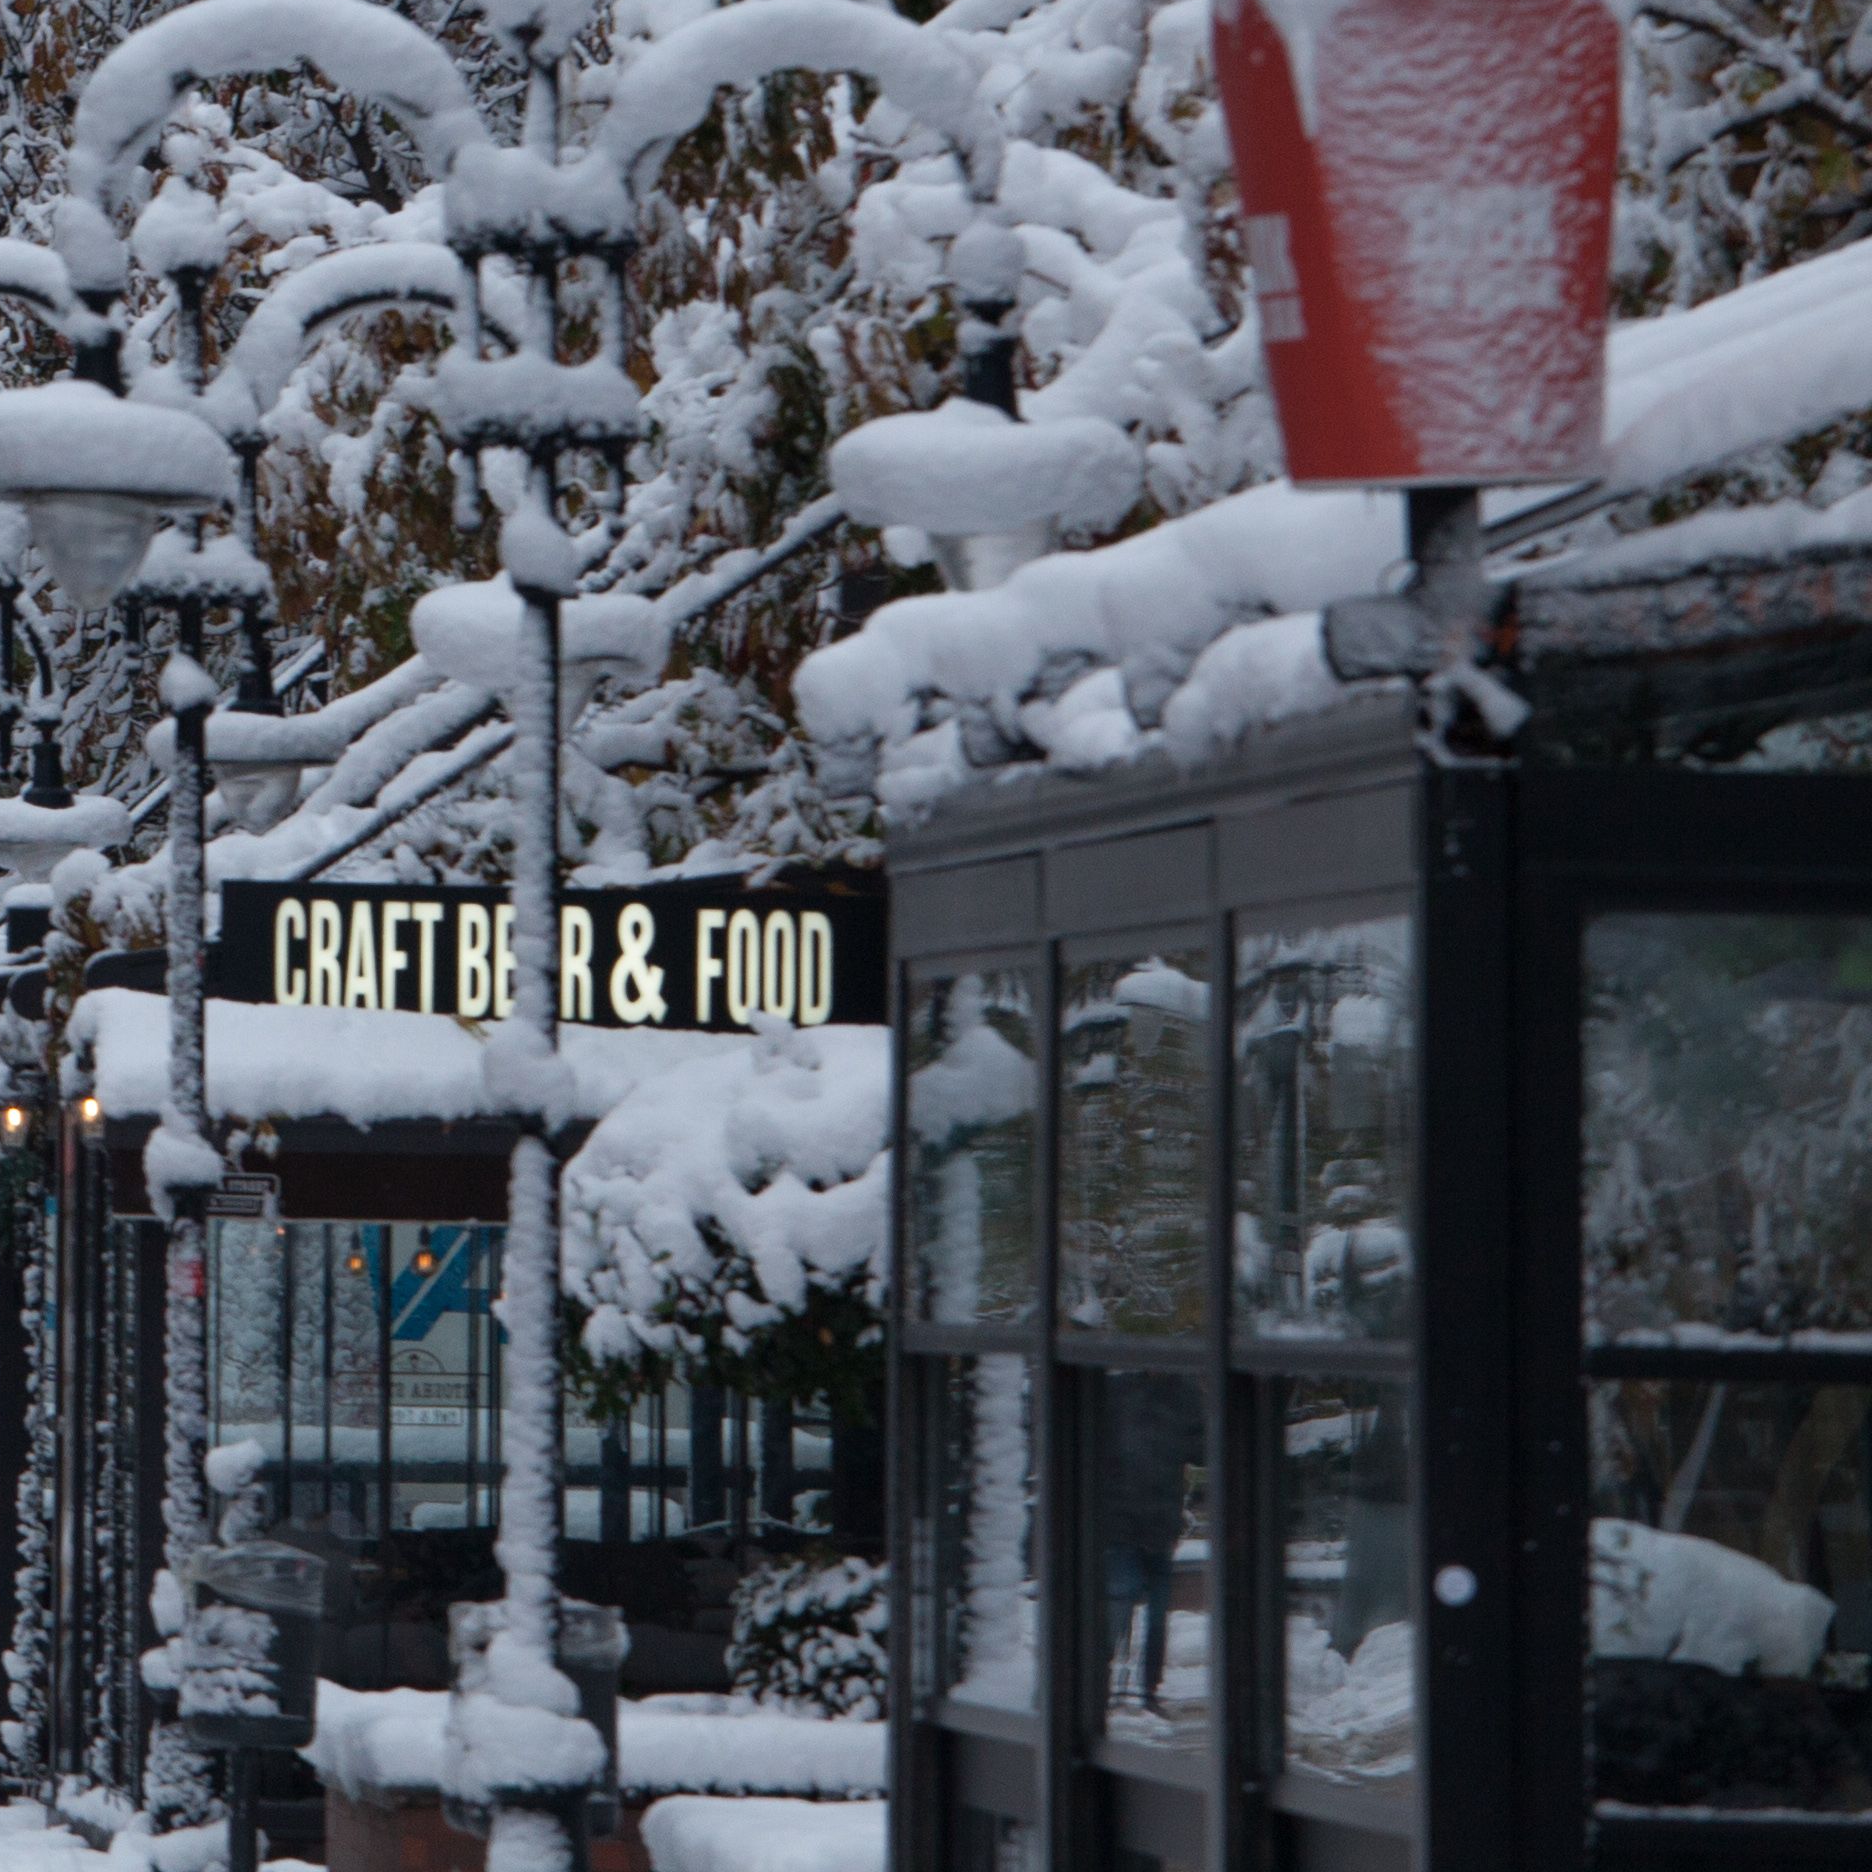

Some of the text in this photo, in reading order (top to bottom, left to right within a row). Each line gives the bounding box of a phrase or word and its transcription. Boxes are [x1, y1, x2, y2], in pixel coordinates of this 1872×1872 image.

[274, 898, 833, 1026] CRAFT BER & FOOD
